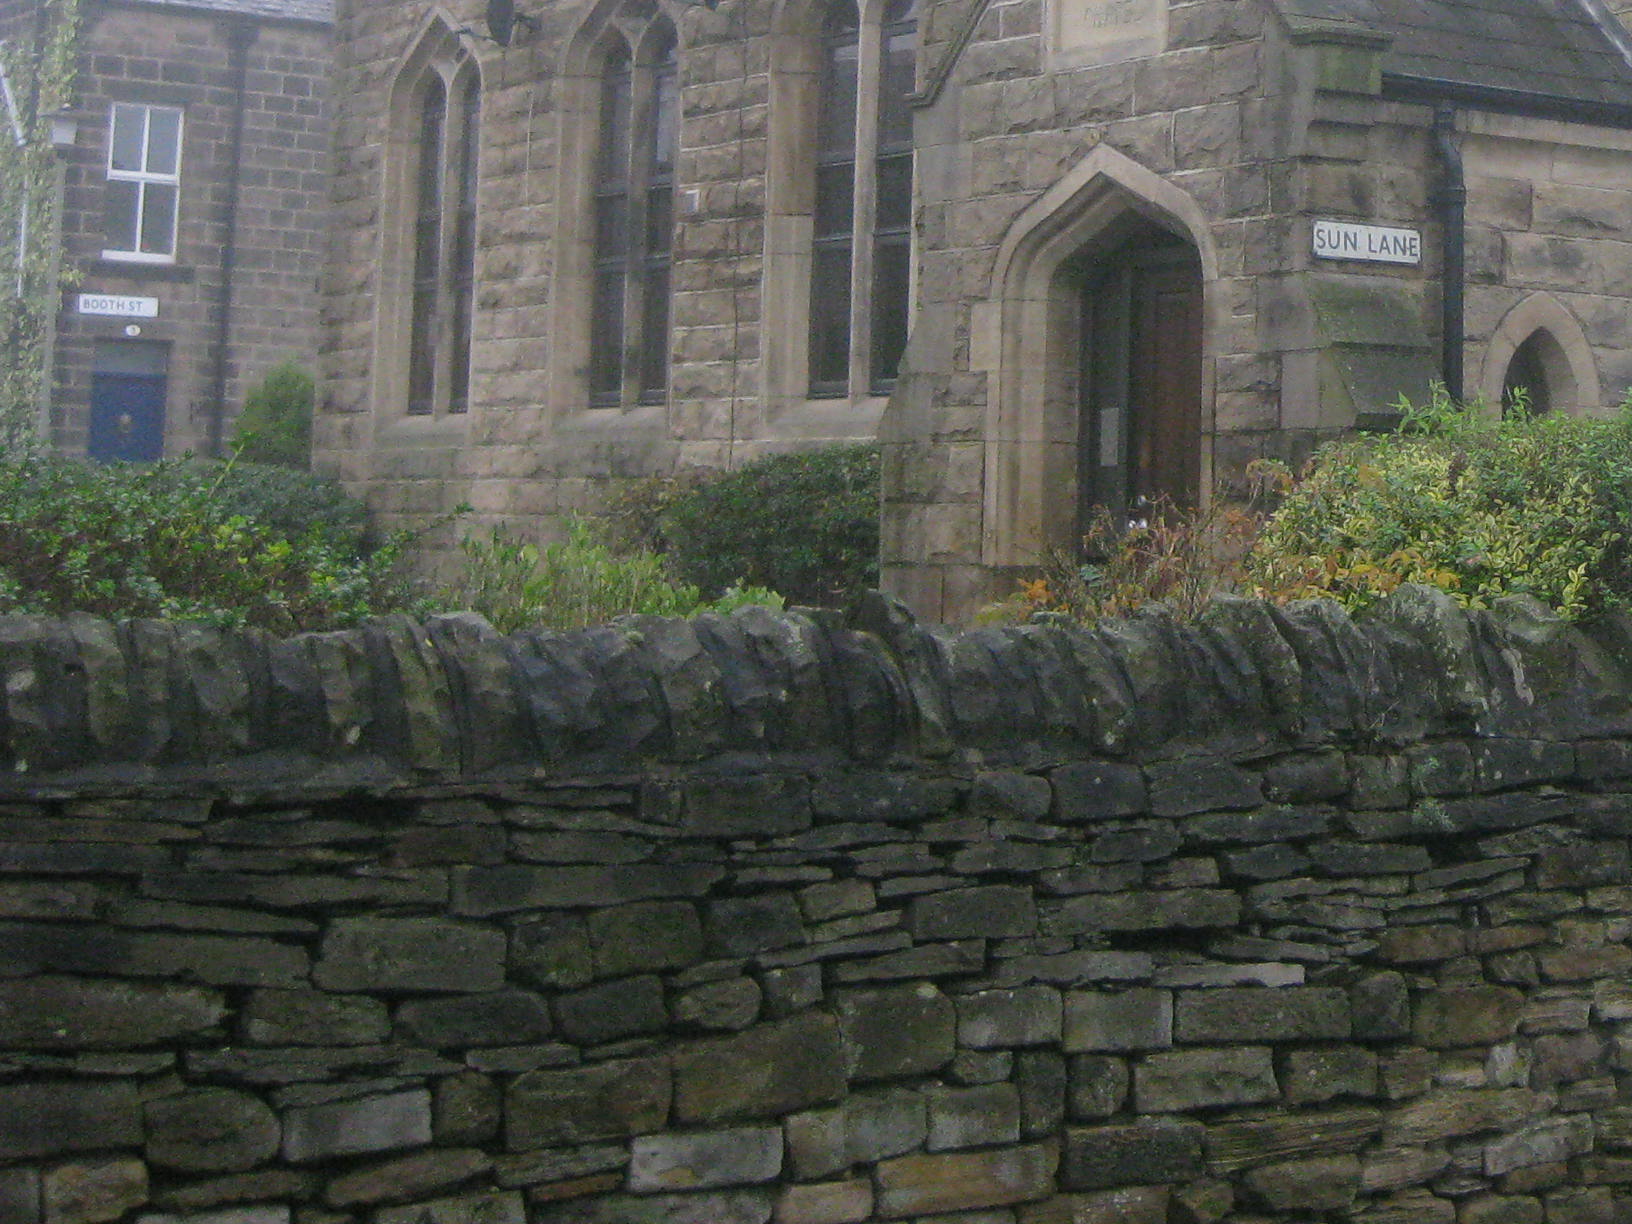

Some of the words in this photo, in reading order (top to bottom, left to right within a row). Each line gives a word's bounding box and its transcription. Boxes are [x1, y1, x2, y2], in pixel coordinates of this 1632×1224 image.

[1315, 229, 1358, 251] SUN
[1368, 233, 1418, 257] LANE
[83, 298, 125, 310] BOOTH
[128, 300, 143, 312] ST
